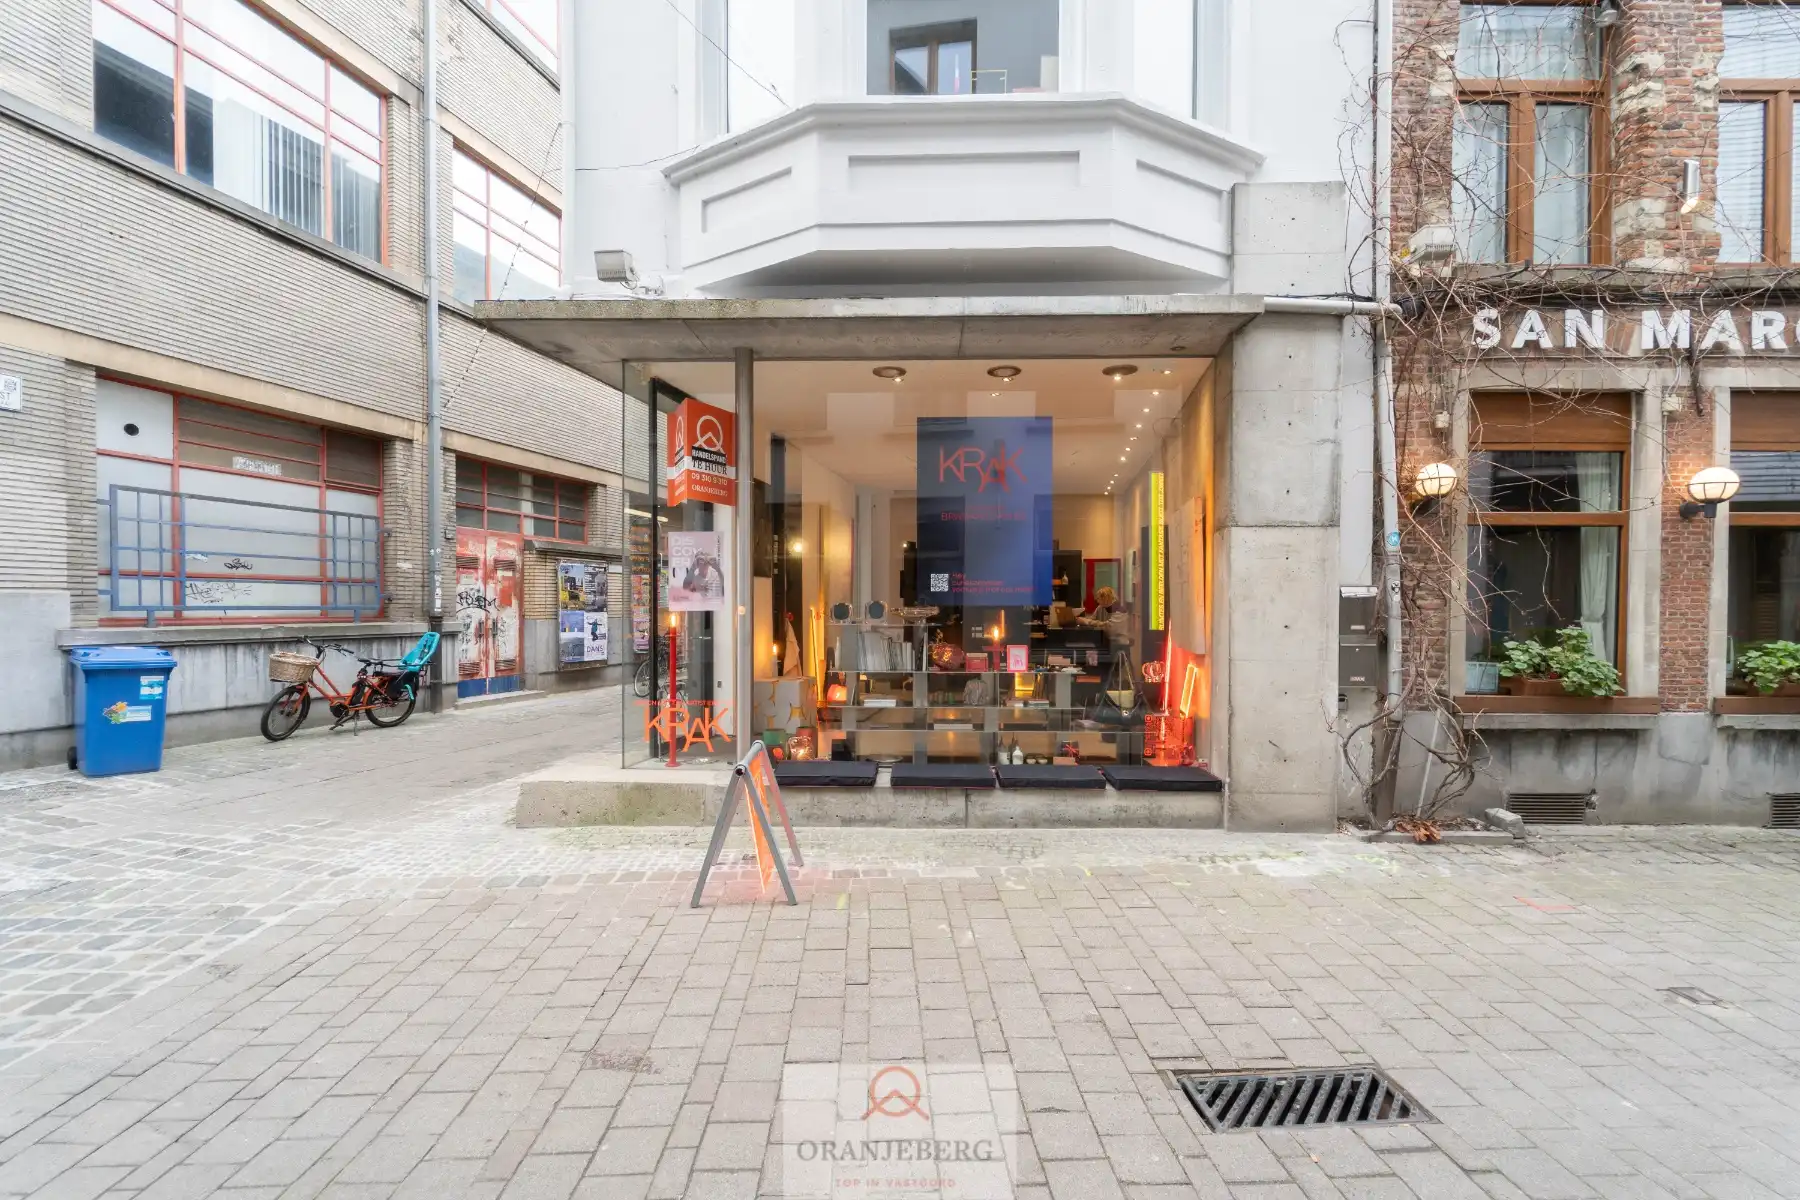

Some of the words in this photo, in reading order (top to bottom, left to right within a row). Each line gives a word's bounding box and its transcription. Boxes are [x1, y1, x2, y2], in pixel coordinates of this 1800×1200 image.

[1472, 307, 1604, 350] SAN
[1641, 308, 1800, 355] MAR
[691, 472, 700, 480] 09
[692, 459, 703, 470] TE
[705, 462, 727, 475] HUUR
[939, 445, 1028, 493] KRAK
[644, 707, 732, 752] KRAK
